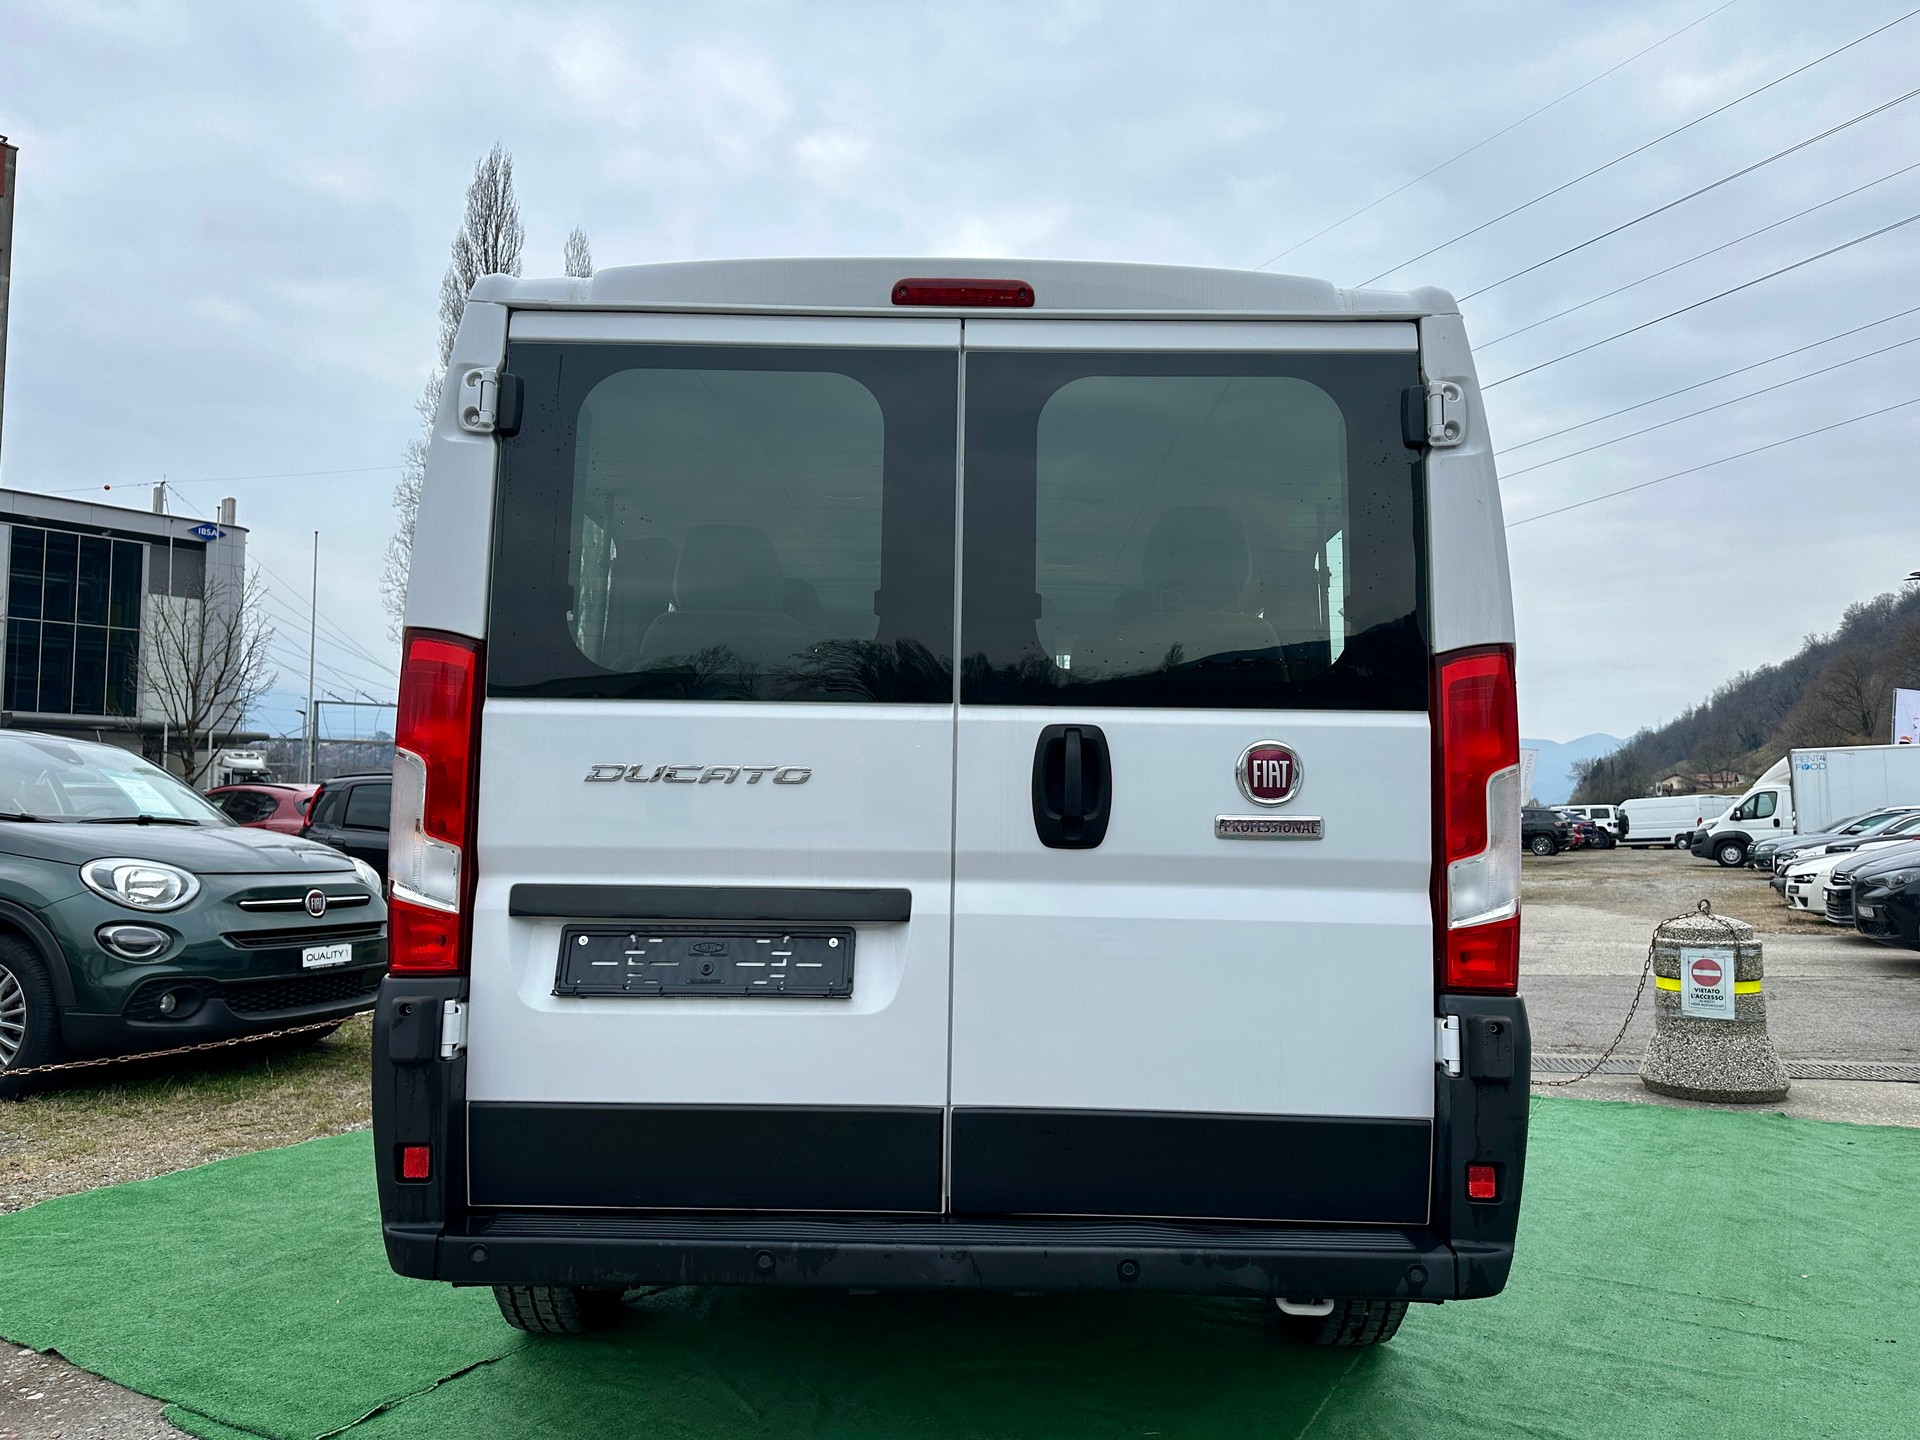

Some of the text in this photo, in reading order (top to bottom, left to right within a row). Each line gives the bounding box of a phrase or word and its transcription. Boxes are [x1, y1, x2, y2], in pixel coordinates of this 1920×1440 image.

[198, 527, 218, 537] IBSA
[584, 763, 812, 785] DUCATO
[1252, 759, 1290, 788] FIAT
[1222, 820, 1318, 834] PROFESSIONAL
[1690, 993, 1724, 1001] L'ACCESSO
[1693, 987, 1721, 995] VIETATO
